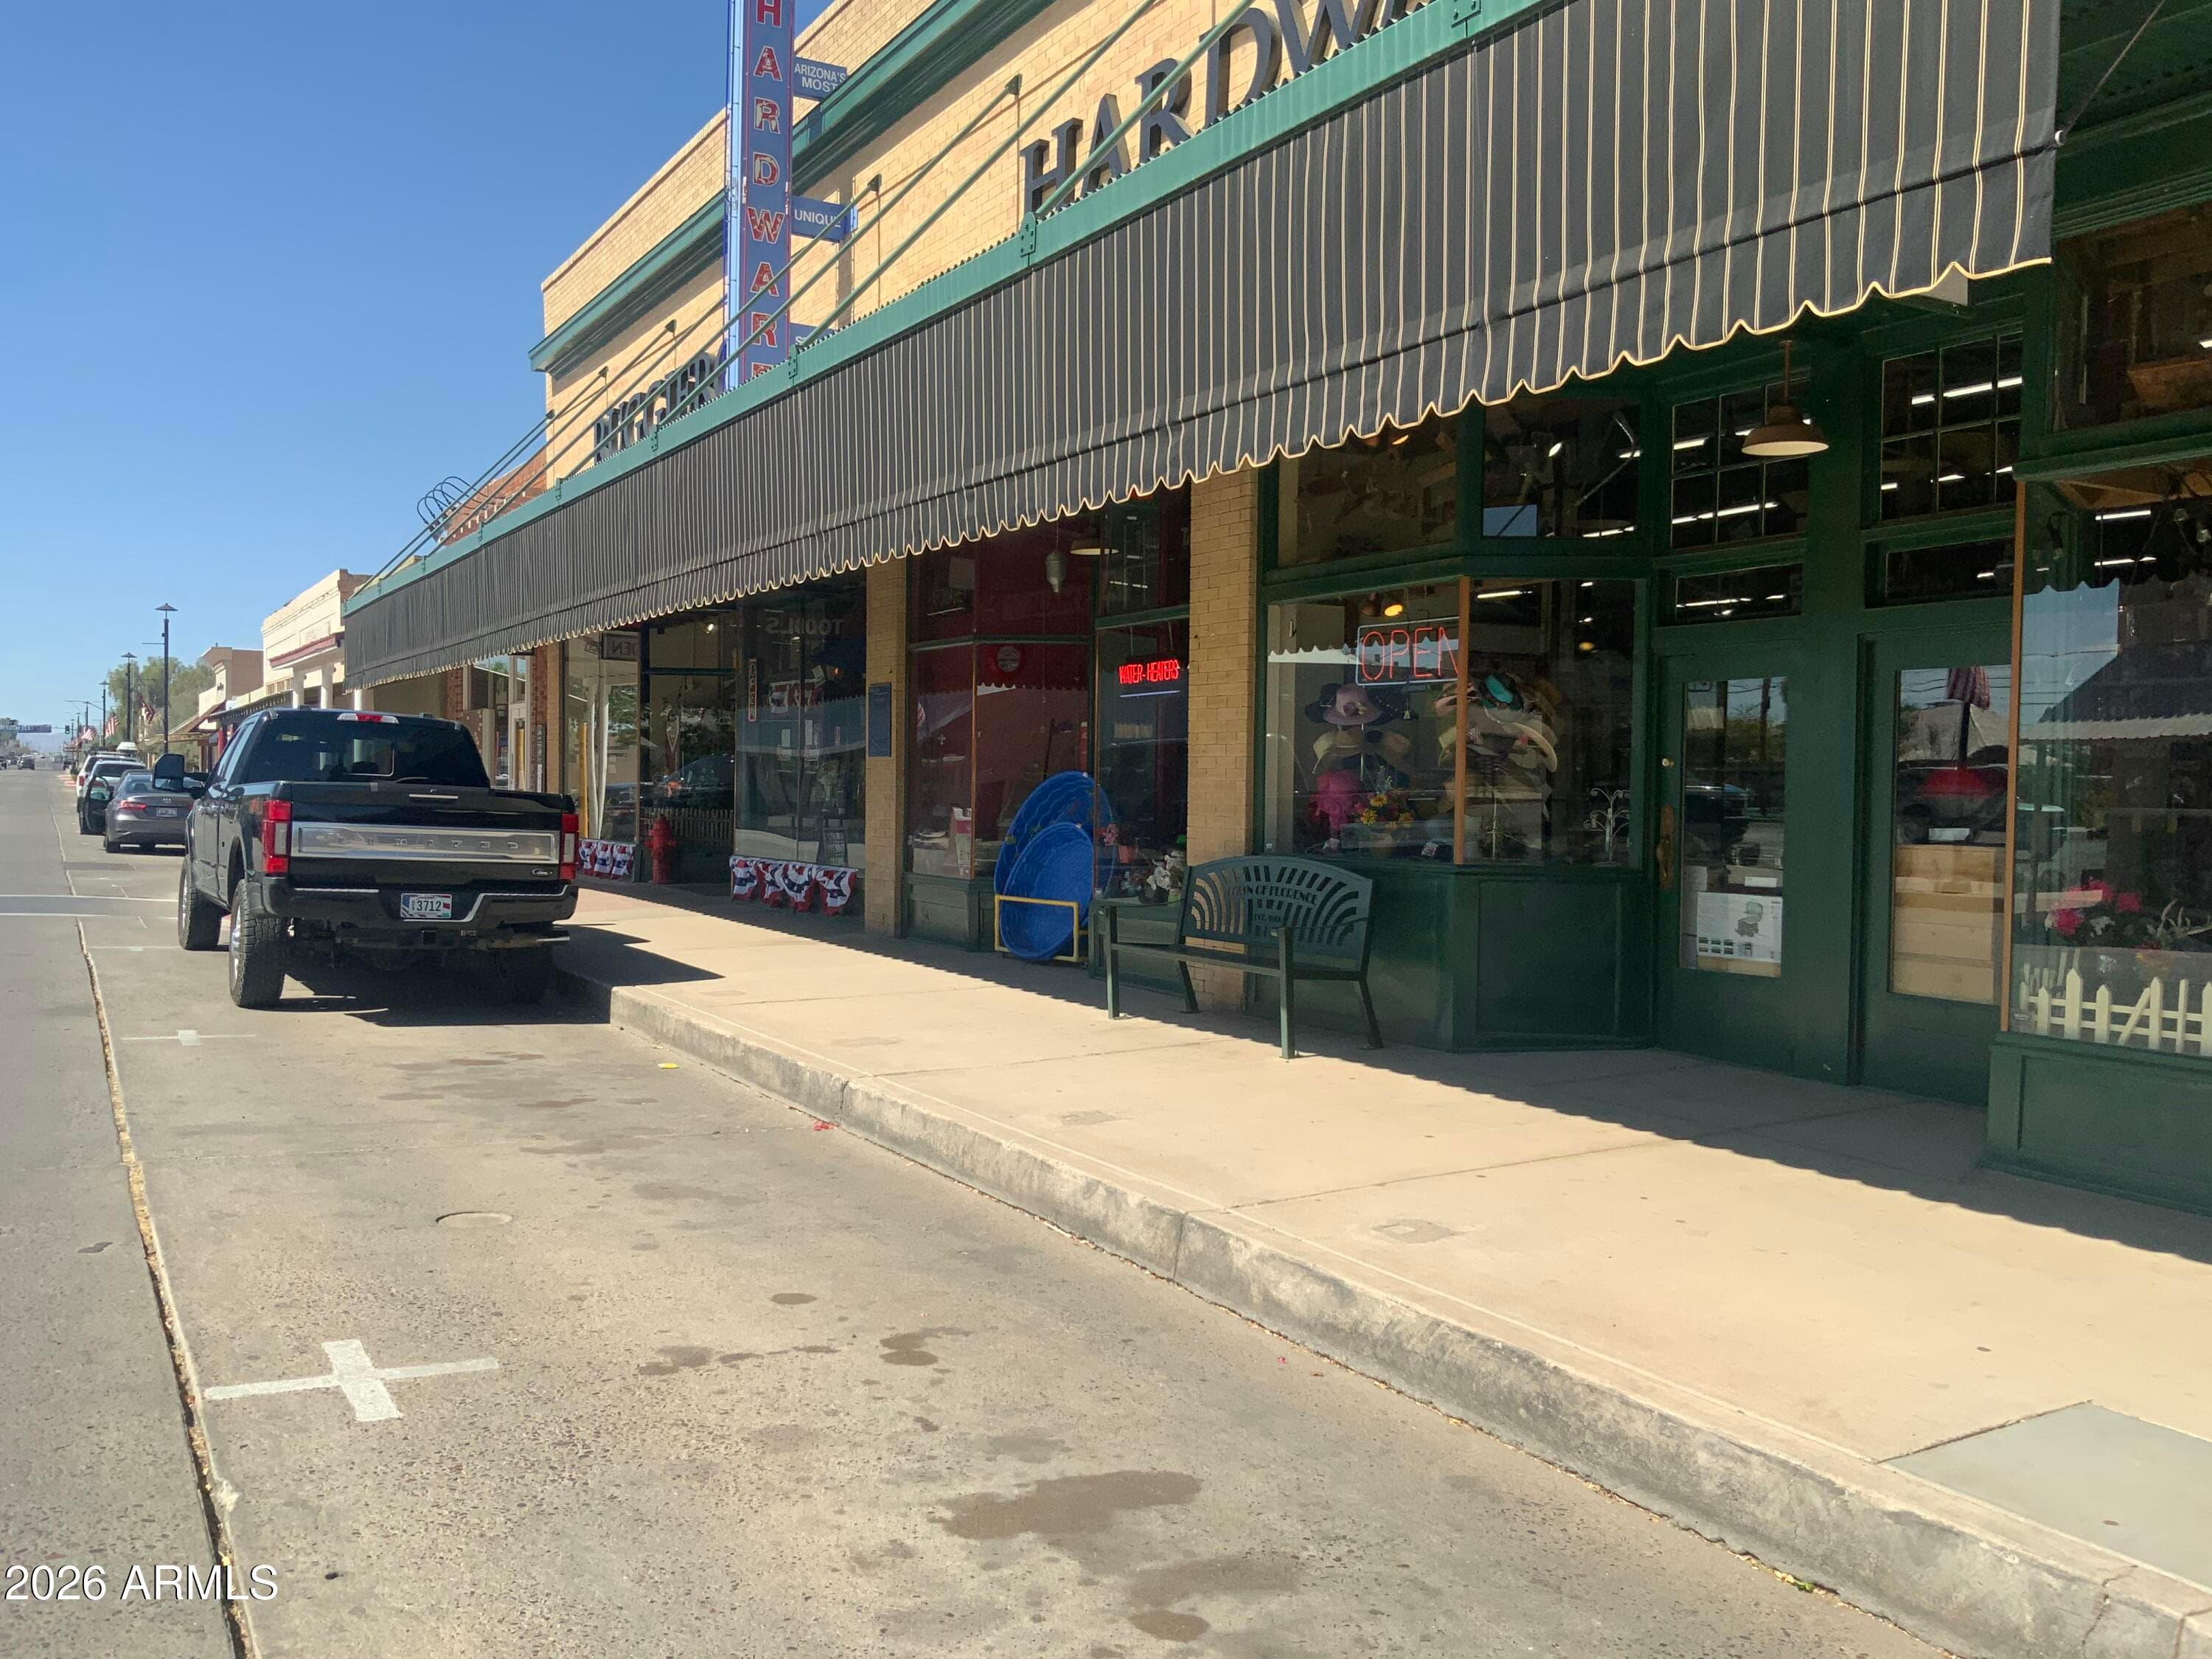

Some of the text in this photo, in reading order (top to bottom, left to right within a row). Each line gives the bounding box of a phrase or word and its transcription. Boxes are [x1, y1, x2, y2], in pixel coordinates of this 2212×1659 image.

[794, 63, 846, 83] ARIZONA'S
[801, 77, 838, 93] MOST
[1020, 0, 1405, 213] HARDW
[1361, 627, 1458, 681] OPEN
[1256, 886, 1267, 895] OF
[1269, 886, 1318, 905] FLORENCE
[417, 900, 442, 911] 3712
